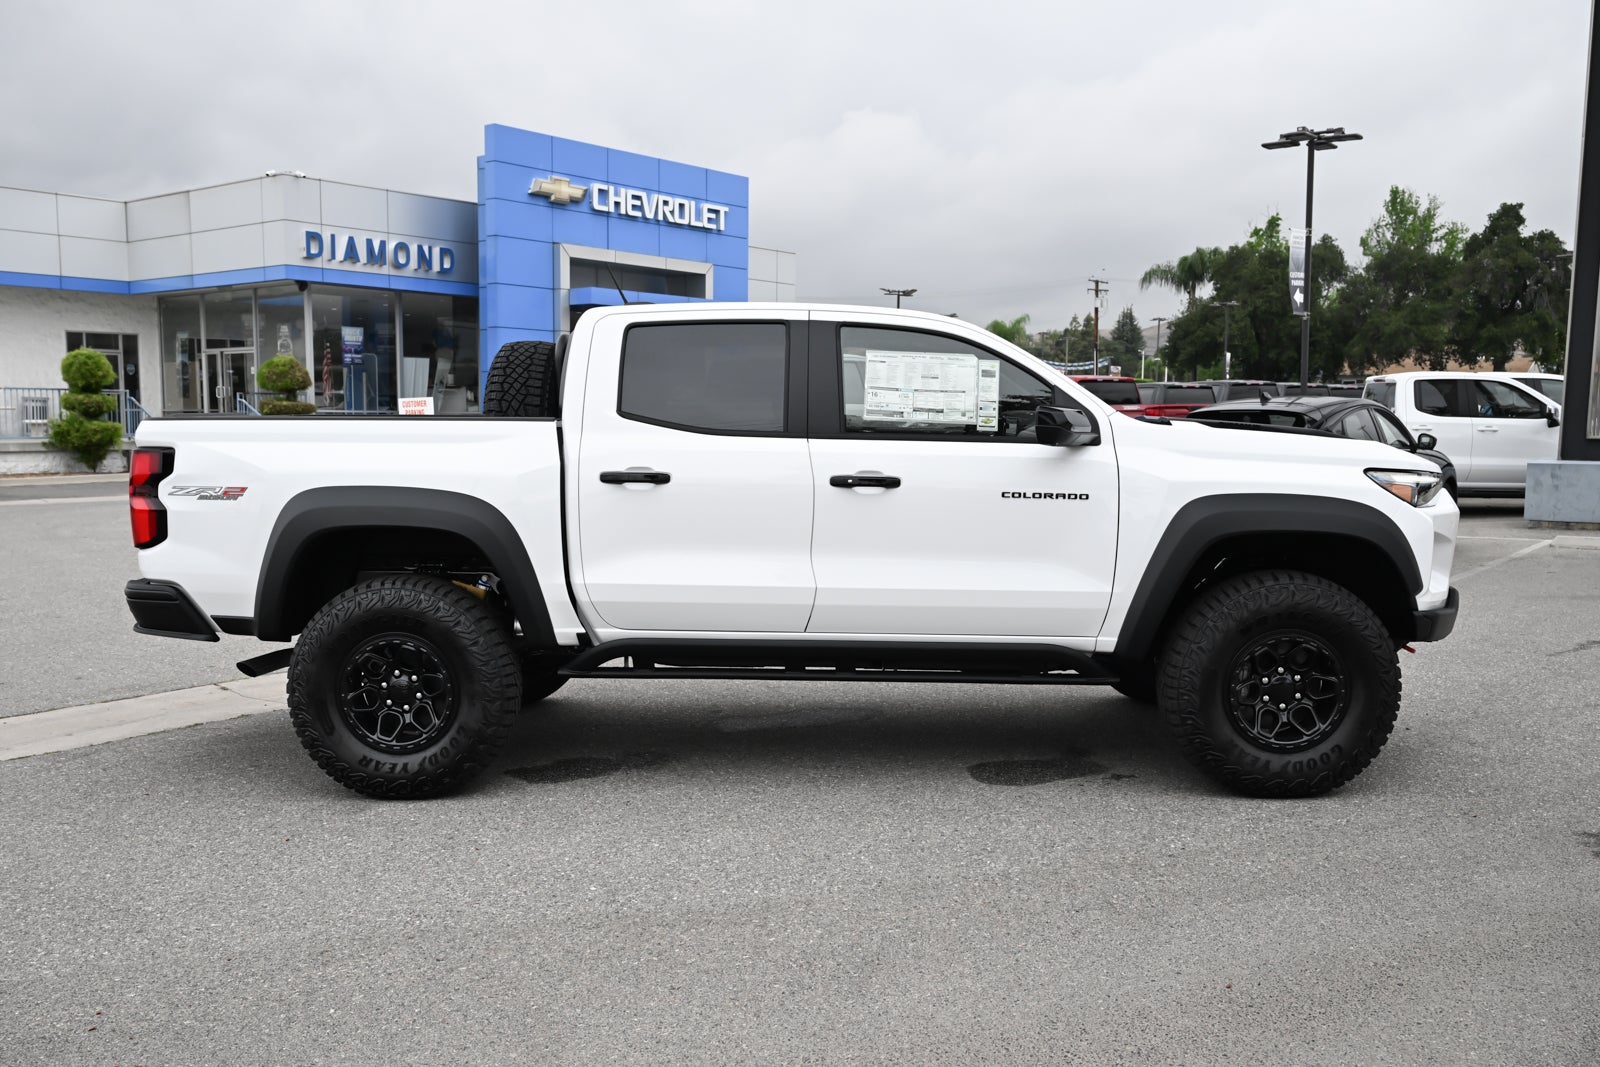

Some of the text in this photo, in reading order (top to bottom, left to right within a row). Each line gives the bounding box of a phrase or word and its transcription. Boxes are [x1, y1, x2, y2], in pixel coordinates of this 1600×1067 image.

[591, 183, 729, 231] CHEVROLET
[305, 230, 455, 273] DIAMOND
[402, 399, 427, 408] CUSTOMER
[168, 485, 248, 496] ZR2
[1001, 491, 1089, 500] COLORADO
[358, 725, 466, 776] GOODYEAR
